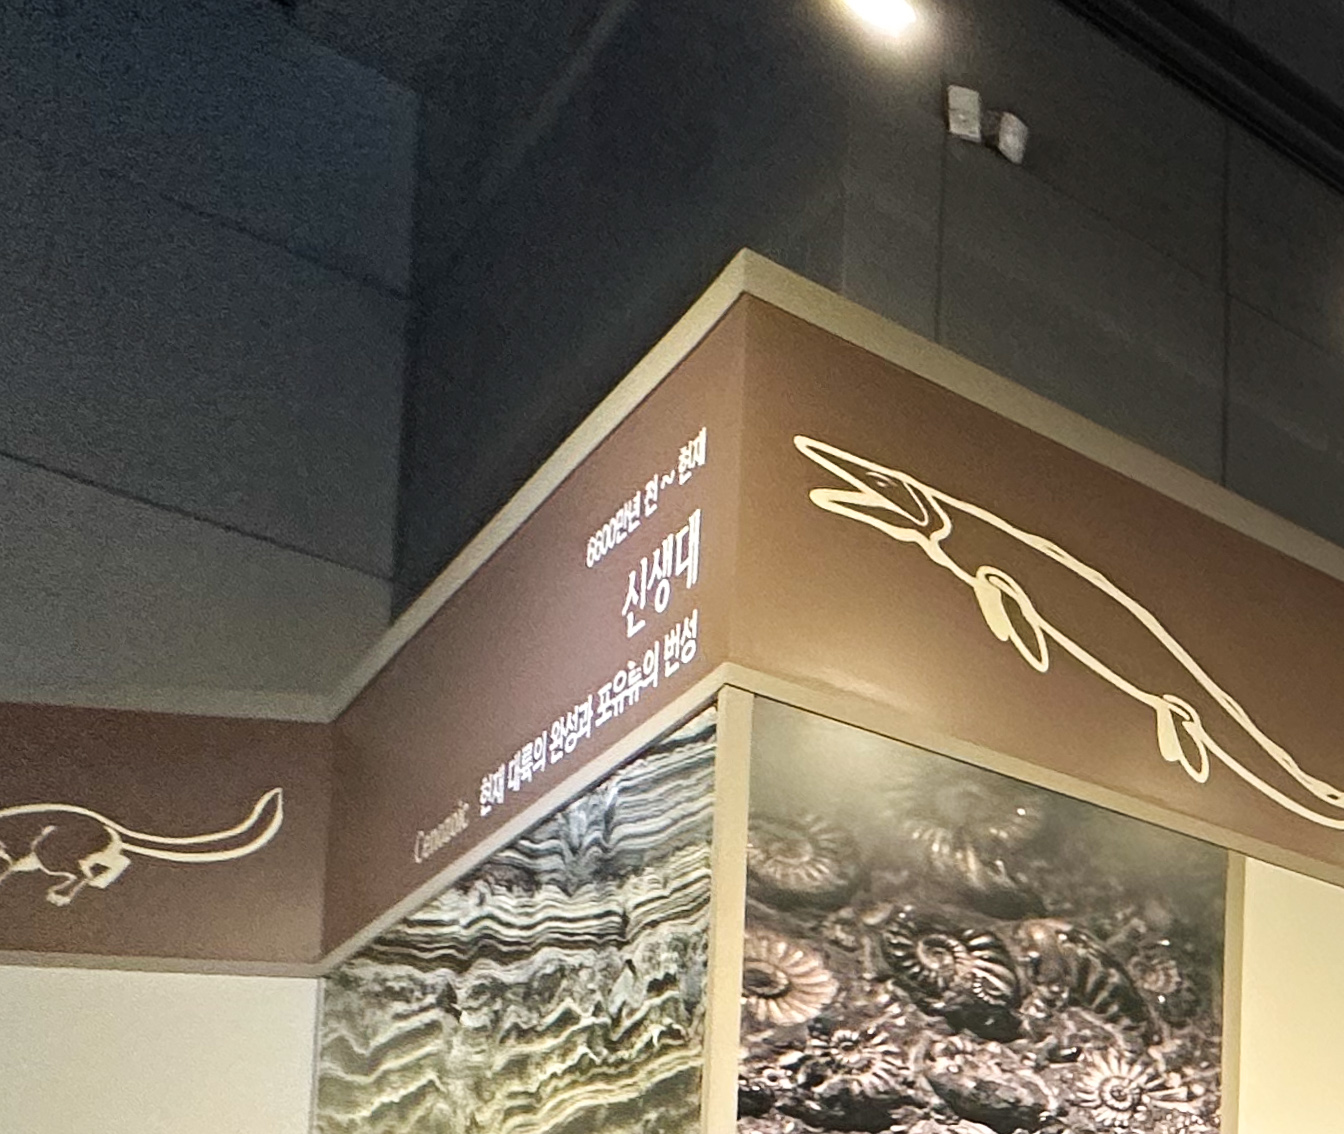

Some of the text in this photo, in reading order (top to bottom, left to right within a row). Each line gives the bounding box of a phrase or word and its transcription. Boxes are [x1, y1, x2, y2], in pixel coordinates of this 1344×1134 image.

[679, 426, 707, 485] 현재
[621, 508, 701, 638] 신생대
[507, 730, 548, 792] 대륙의
[549, 694, 594, 765] 완성과
[595, 640, 660, 727] 포유류의
[664, 608, 698, 677] 번성
